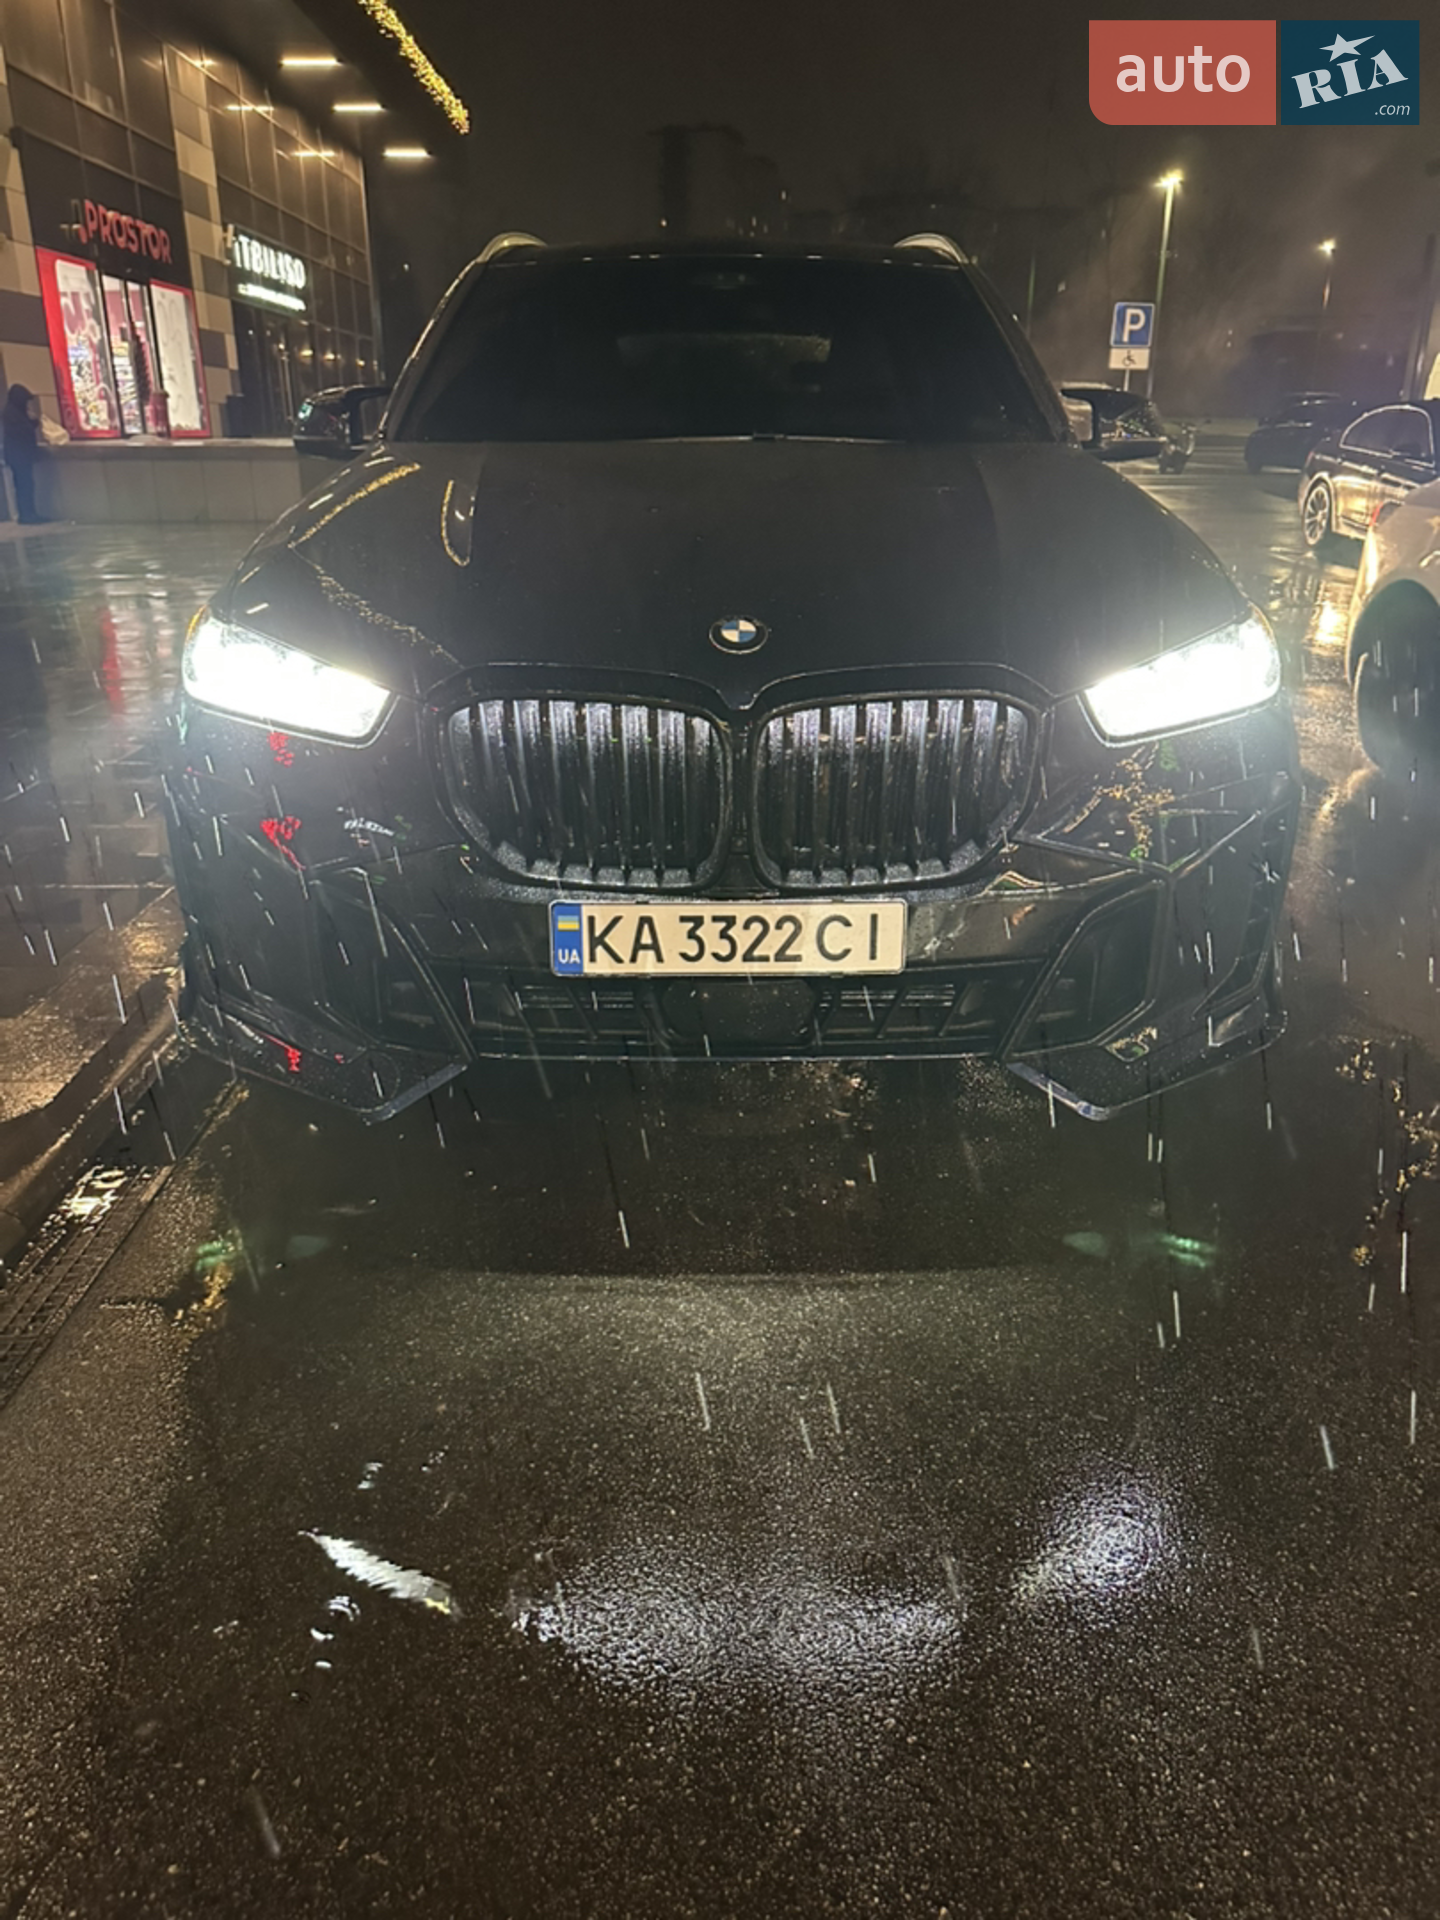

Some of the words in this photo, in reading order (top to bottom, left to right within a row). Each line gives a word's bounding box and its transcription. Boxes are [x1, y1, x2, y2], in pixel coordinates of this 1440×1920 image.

[84, 199, 173, 264] PROSTOR
[1123, 308, 1146, 343] P
[558, 949, 580, 964] UA
[587, 914, 664, 964] KA
[678, 914, 803, 963] 3322
[815, 913, 878, 962] CI
